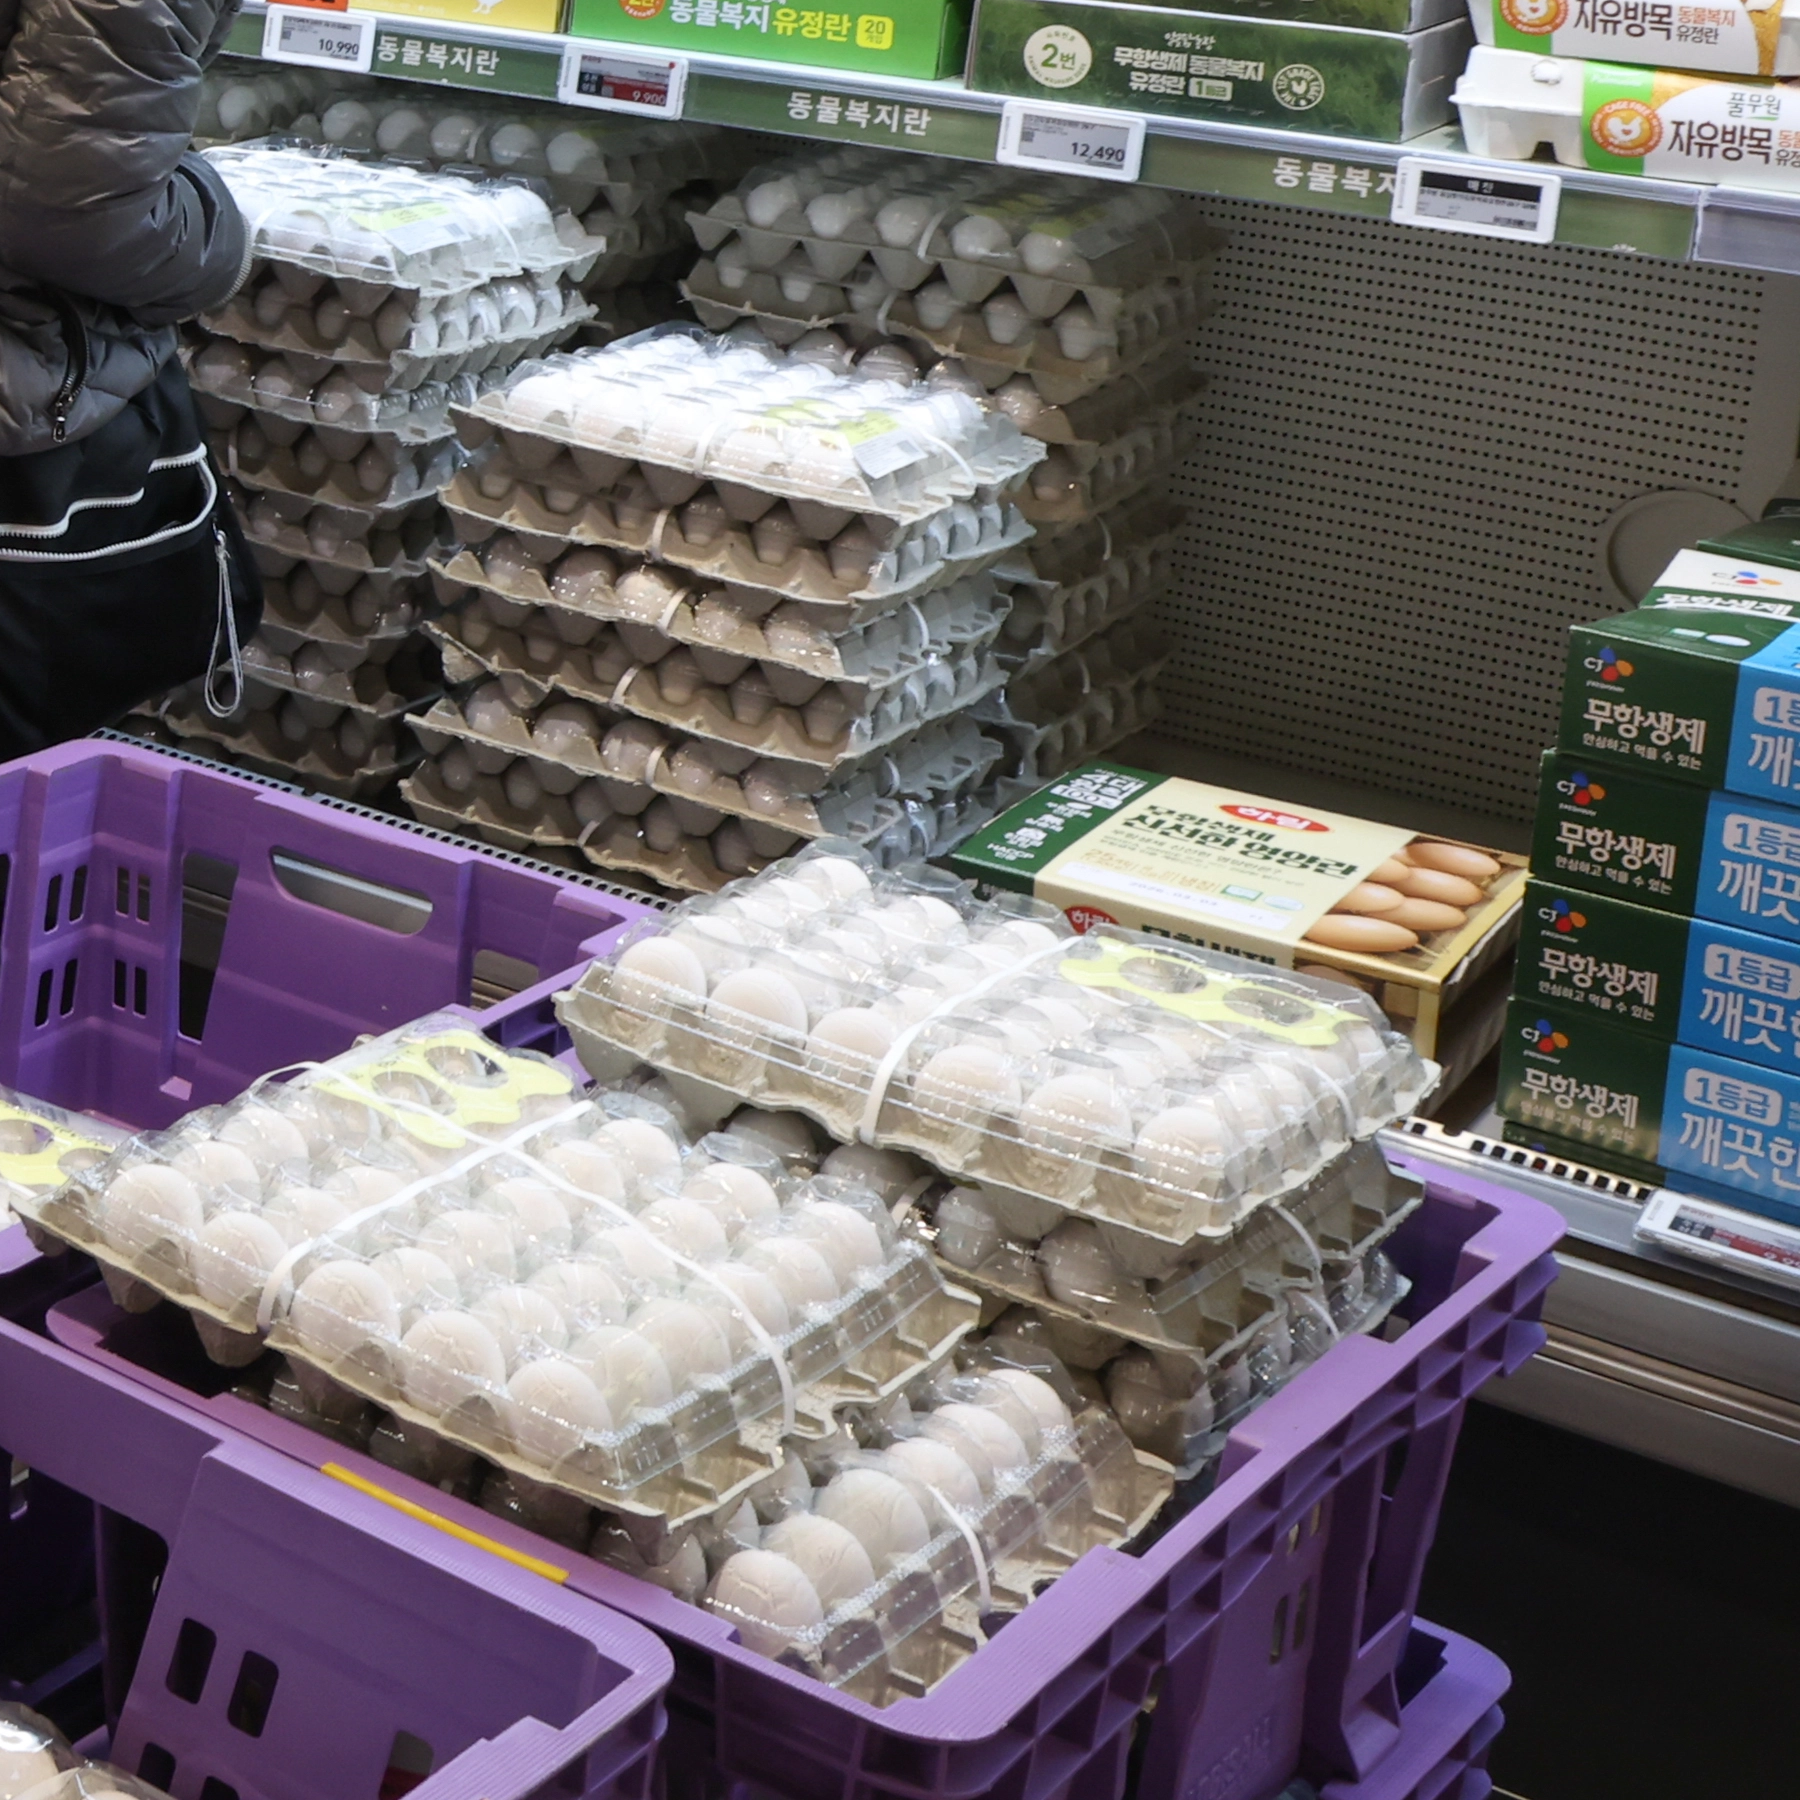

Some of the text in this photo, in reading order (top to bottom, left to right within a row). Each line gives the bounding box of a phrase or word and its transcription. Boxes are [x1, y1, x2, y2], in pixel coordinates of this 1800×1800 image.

[772, 7, 851, 42] 유정란
[865, 20, 886, 35] 20
[1678, 6, 1736, 28] 동물복지
[318, 38, 359, 56] 10,990
[1677, 24, 1719, 46] 유정란
[376, 35, 500, 77] 동물복지란
[1041, 42, 1077, 70] 2번
[1114, 45, 1265, 82] 무항생제 동물복지
[632, 89, 668, 106] 9,900
[1130, 72, 1185, 97] 유정란
[787, 91, 932, 137] 동물복지란
[1727, 91, 1781, 119] 풀무원
[1070, 141, 1126, 162] 12,490
[1668, 120, 1773, 166] 자유방목
[1584, 698, 1707, 754] 무항생제
[1237, 806, 1310, 832] 하림
[1556, 821, 1678, 880] 무항생제
[1539, 947, 1793, 1007] 무항생제 1등급
[1521, 1067, 1772, 1129] 무항생제 1등급
